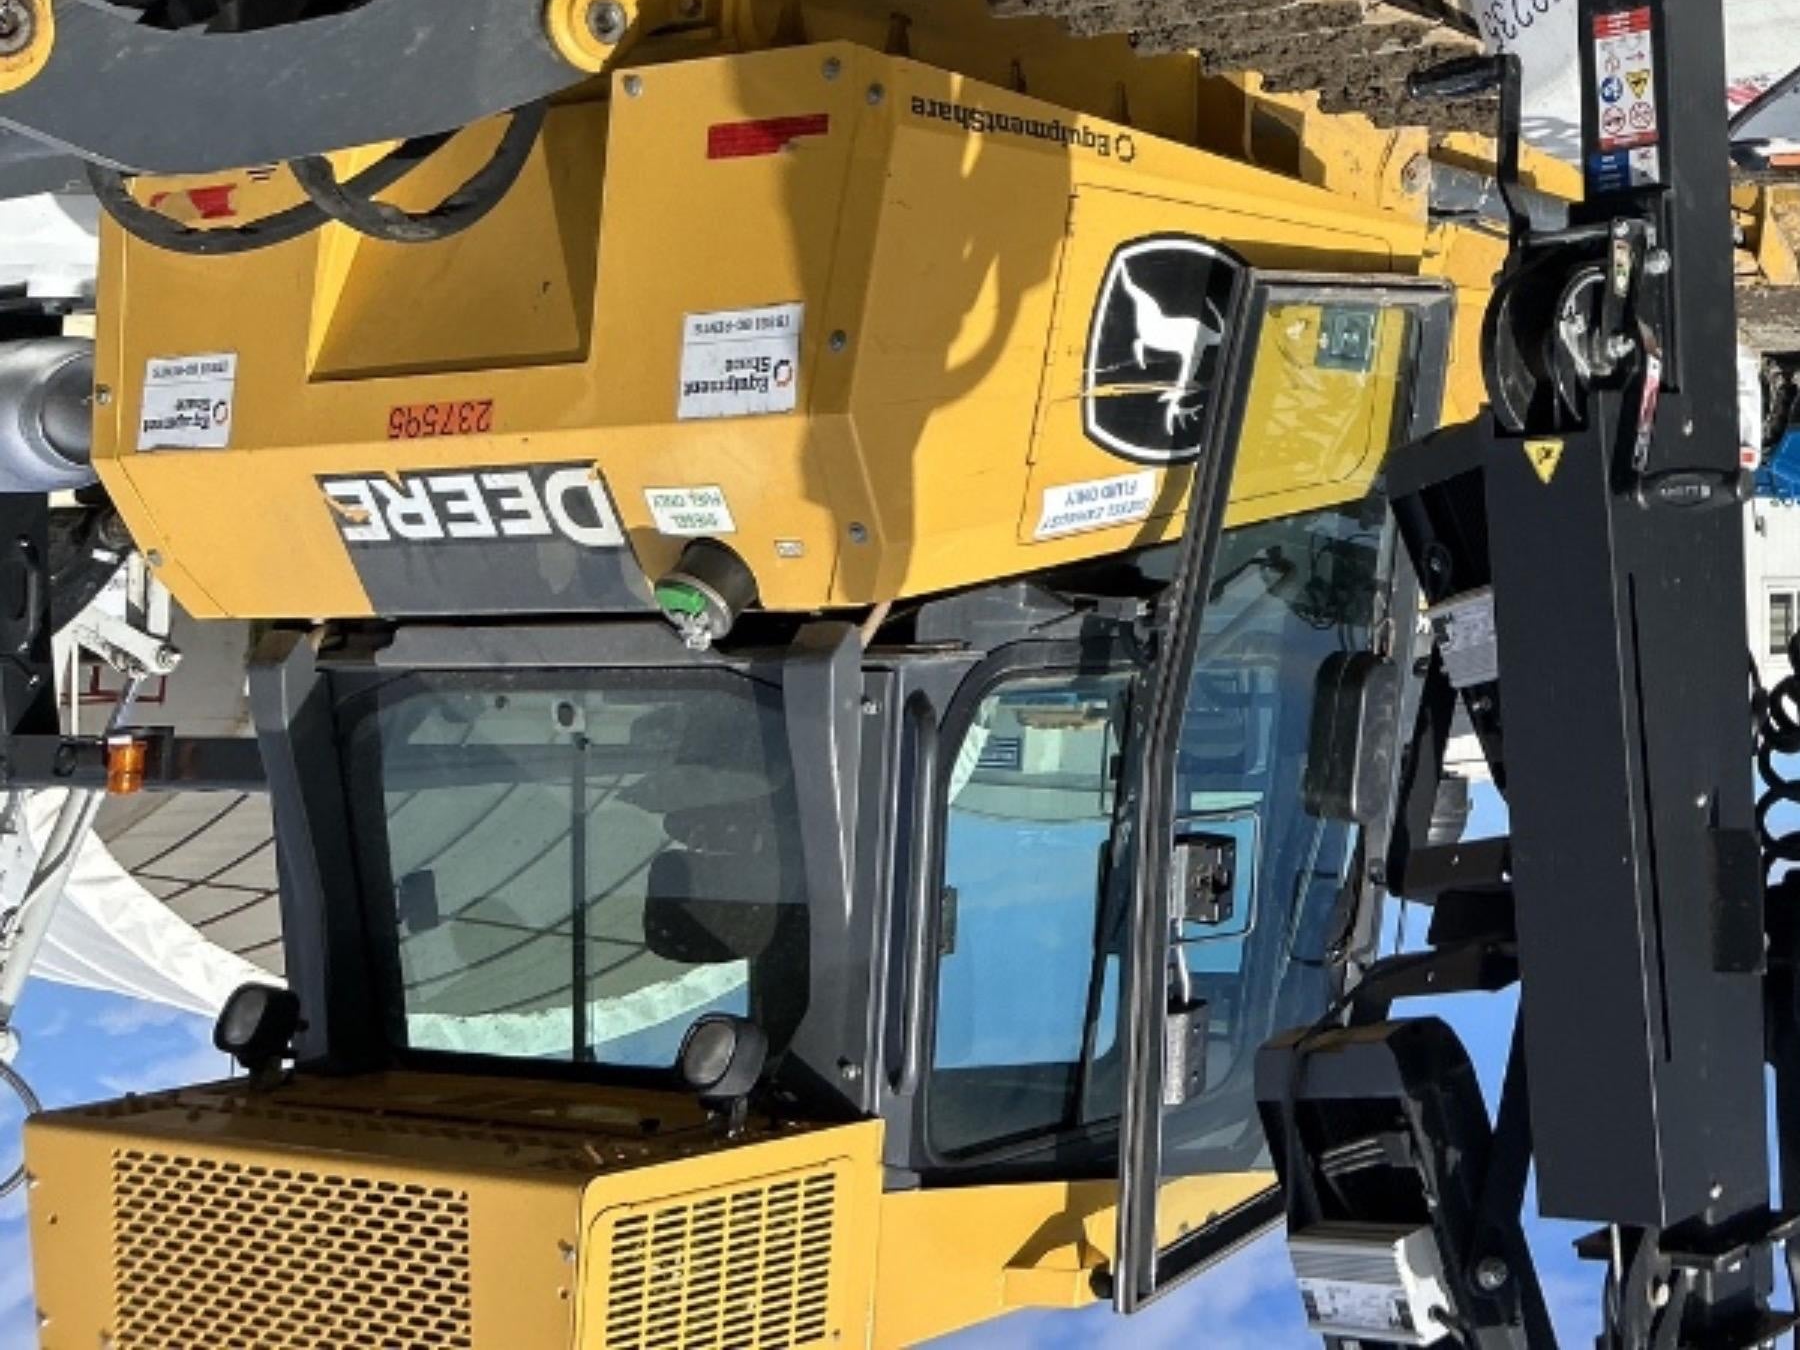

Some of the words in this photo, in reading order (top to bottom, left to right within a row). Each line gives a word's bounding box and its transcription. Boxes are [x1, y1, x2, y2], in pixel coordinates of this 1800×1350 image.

[910, 95, 1111, 158] EquipmentShare
[683, 373, 769, 397] Equipment
[724, 356, 772, 374] Share
[388, 399, 493, 439] 237595
[324, 466, 624, 546] DEERE
